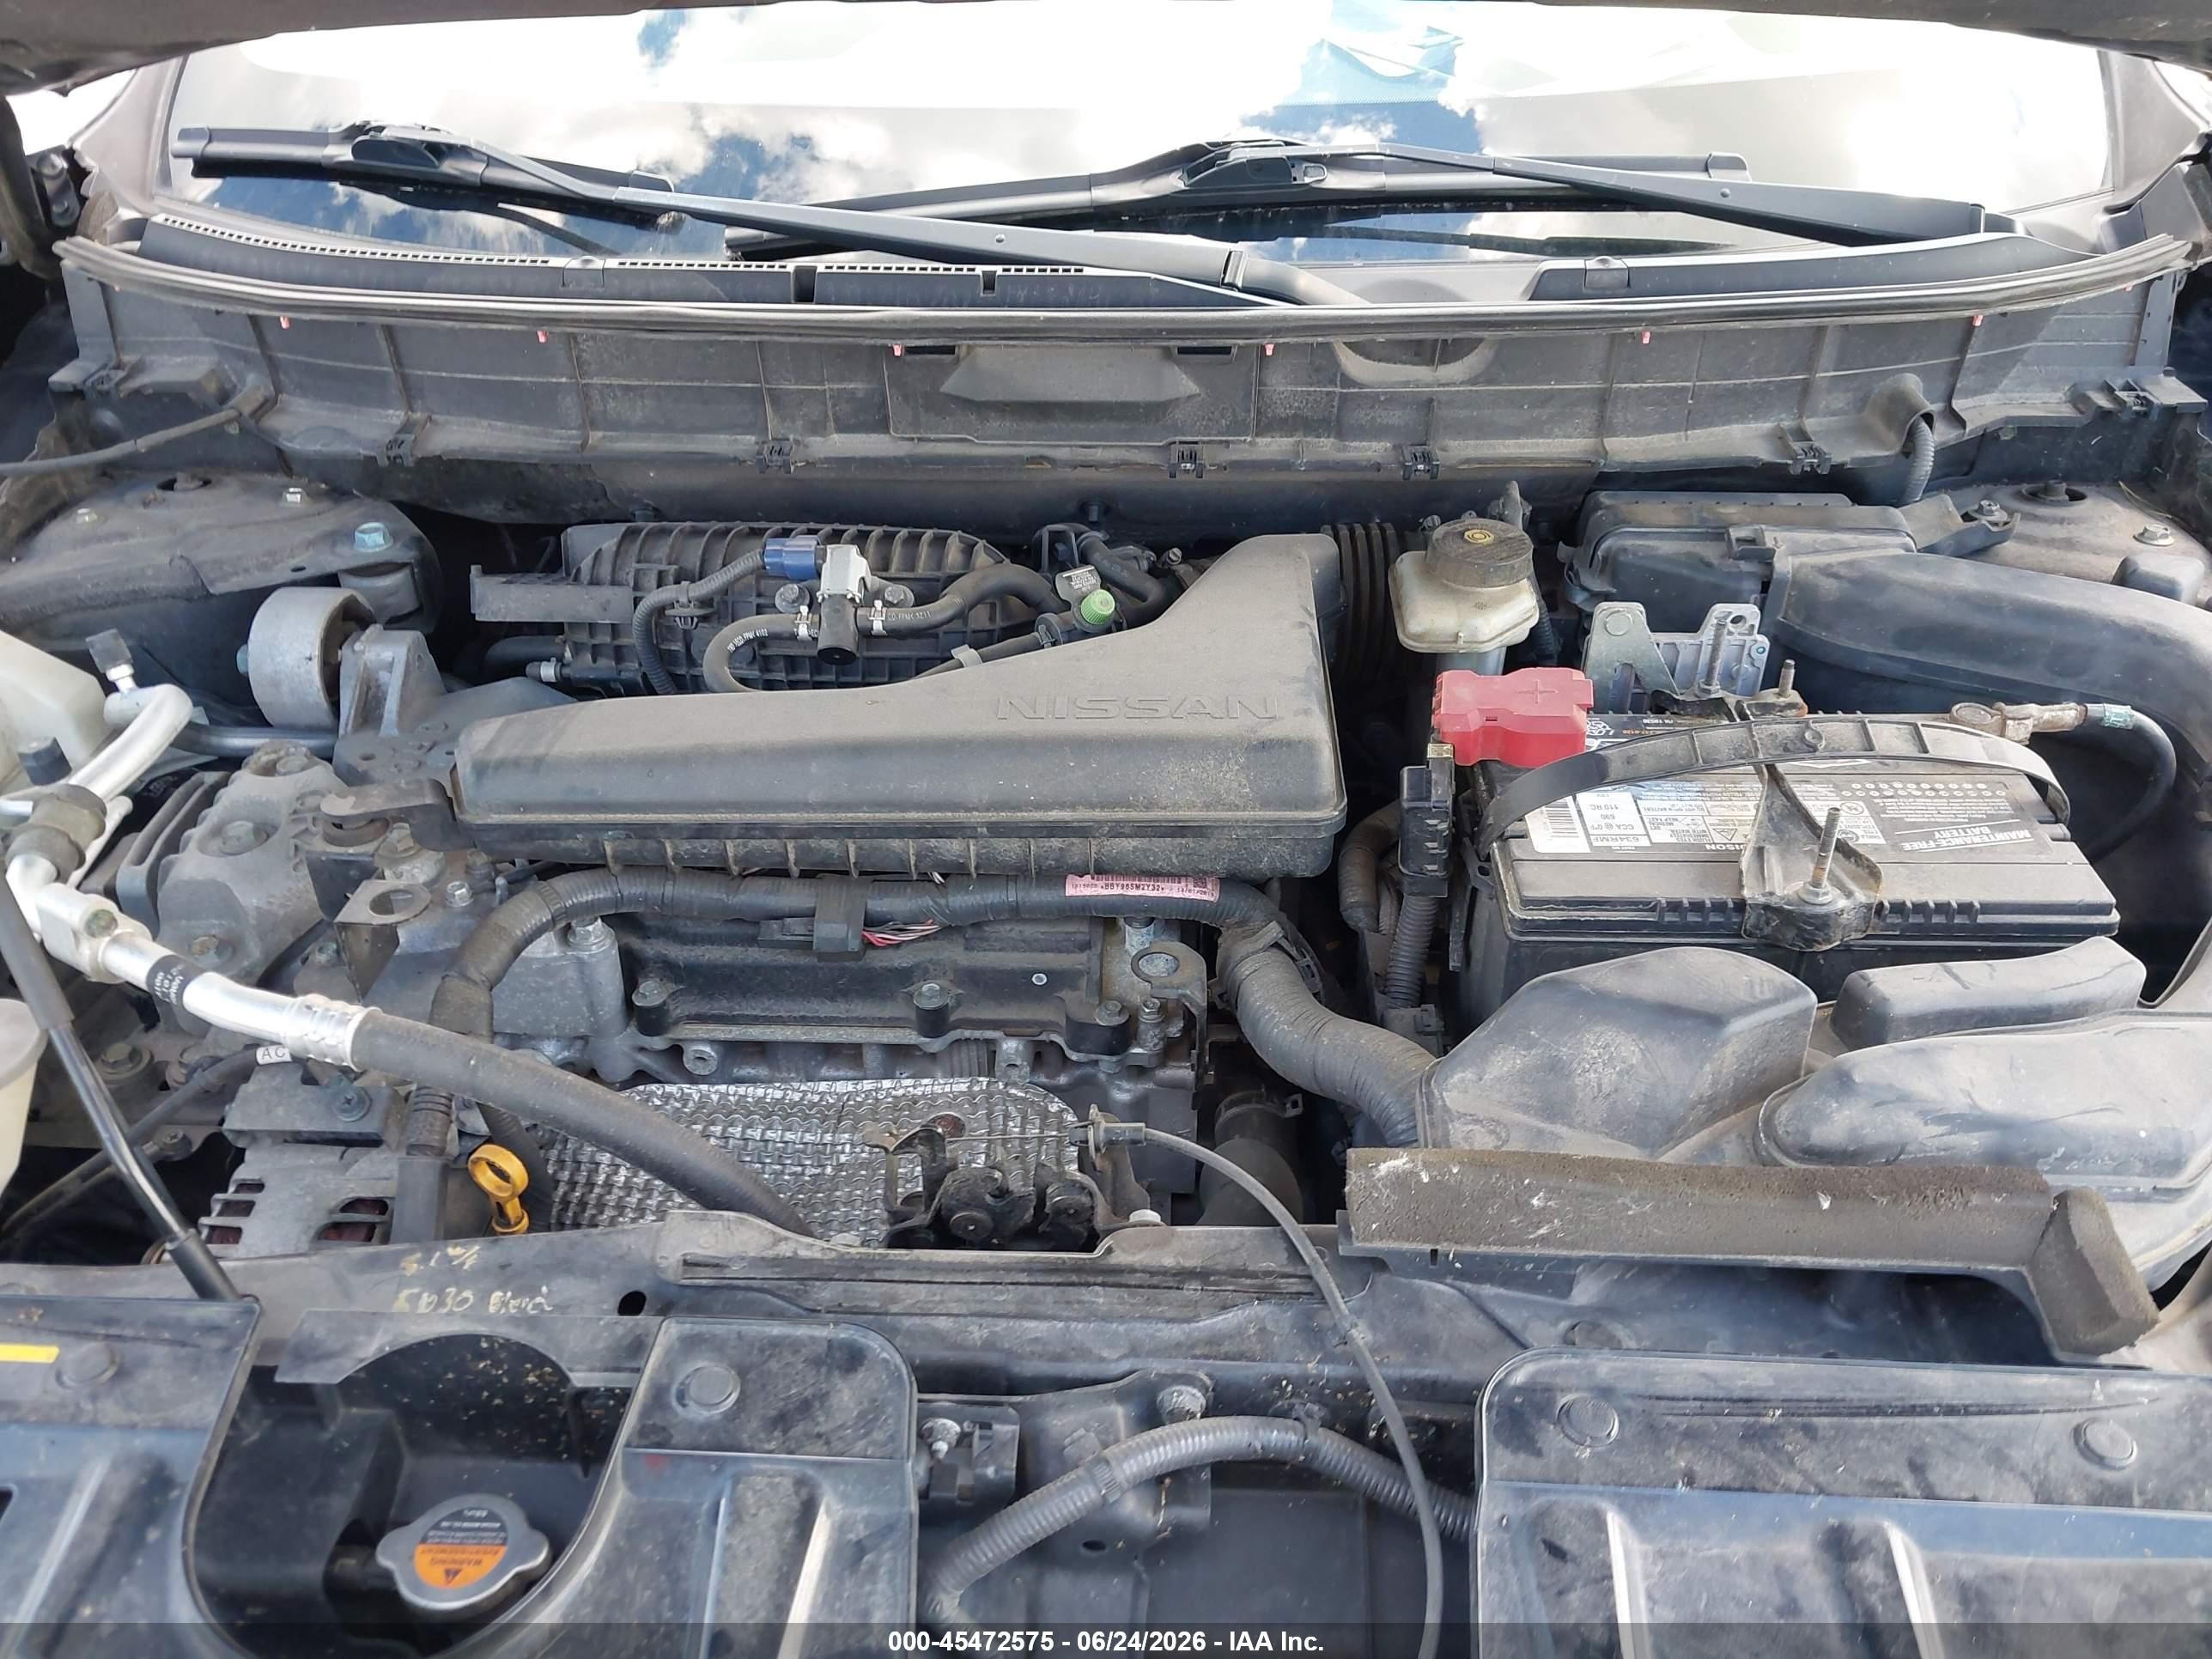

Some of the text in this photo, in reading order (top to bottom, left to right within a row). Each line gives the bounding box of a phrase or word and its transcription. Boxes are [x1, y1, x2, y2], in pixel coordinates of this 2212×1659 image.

[997, 695, 1278, 720] NISSAN
[1900, 829, 2033, 851] MAINTENANCE-FREE
[1933, 825, 1991, 840] BATTERY
